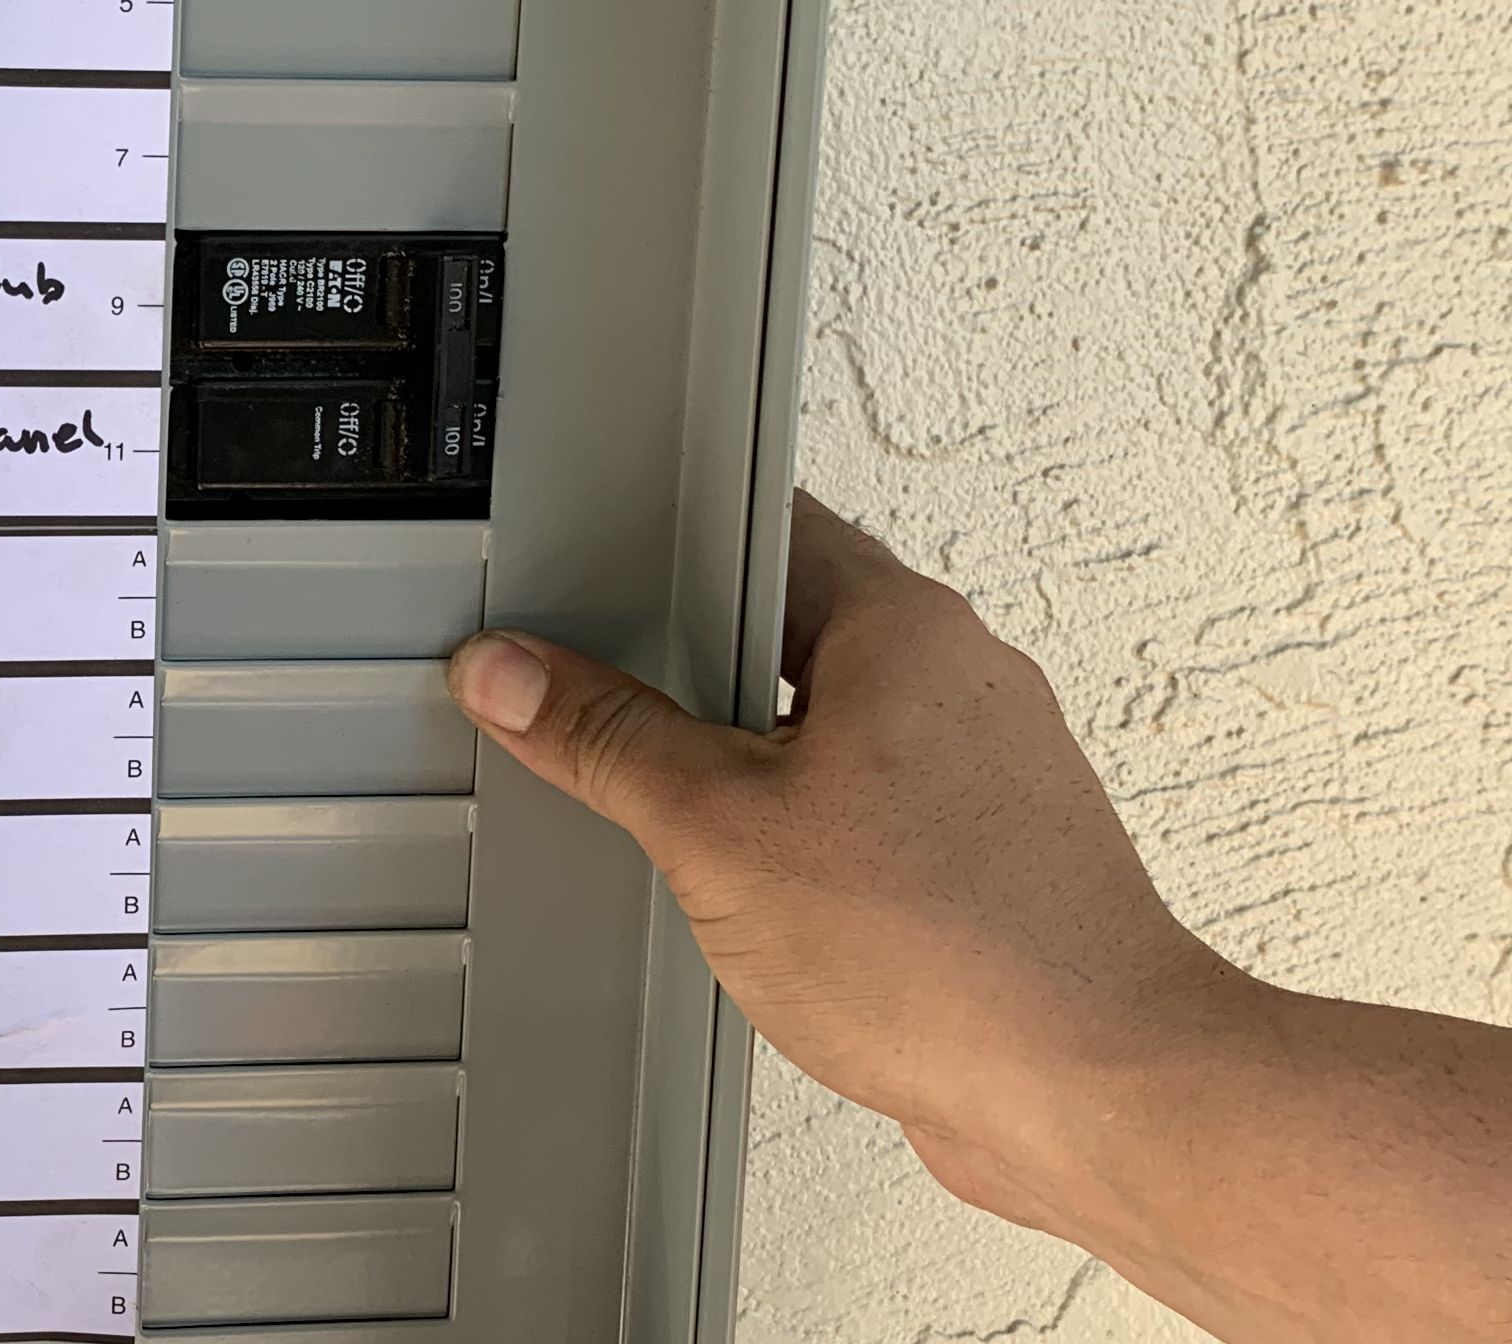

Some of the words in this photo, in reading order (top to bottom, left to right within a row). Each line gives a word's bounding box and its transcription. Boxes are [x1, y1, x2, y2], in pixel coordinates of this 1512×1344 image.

[116, 149, 128, 167] 7
[111, 296, 124, 315] 9
[445, 426, 460, 456] 100
[104, 443, 124, 461] 11
[132, 551, 146, 567] A
[130, 621, 145, 639] B
[125, 829, 140, 846] A
[124, 897, 138, 914] B
[118, 1097, 132, 1114] A
[116, 1163, 130, 1180] B
